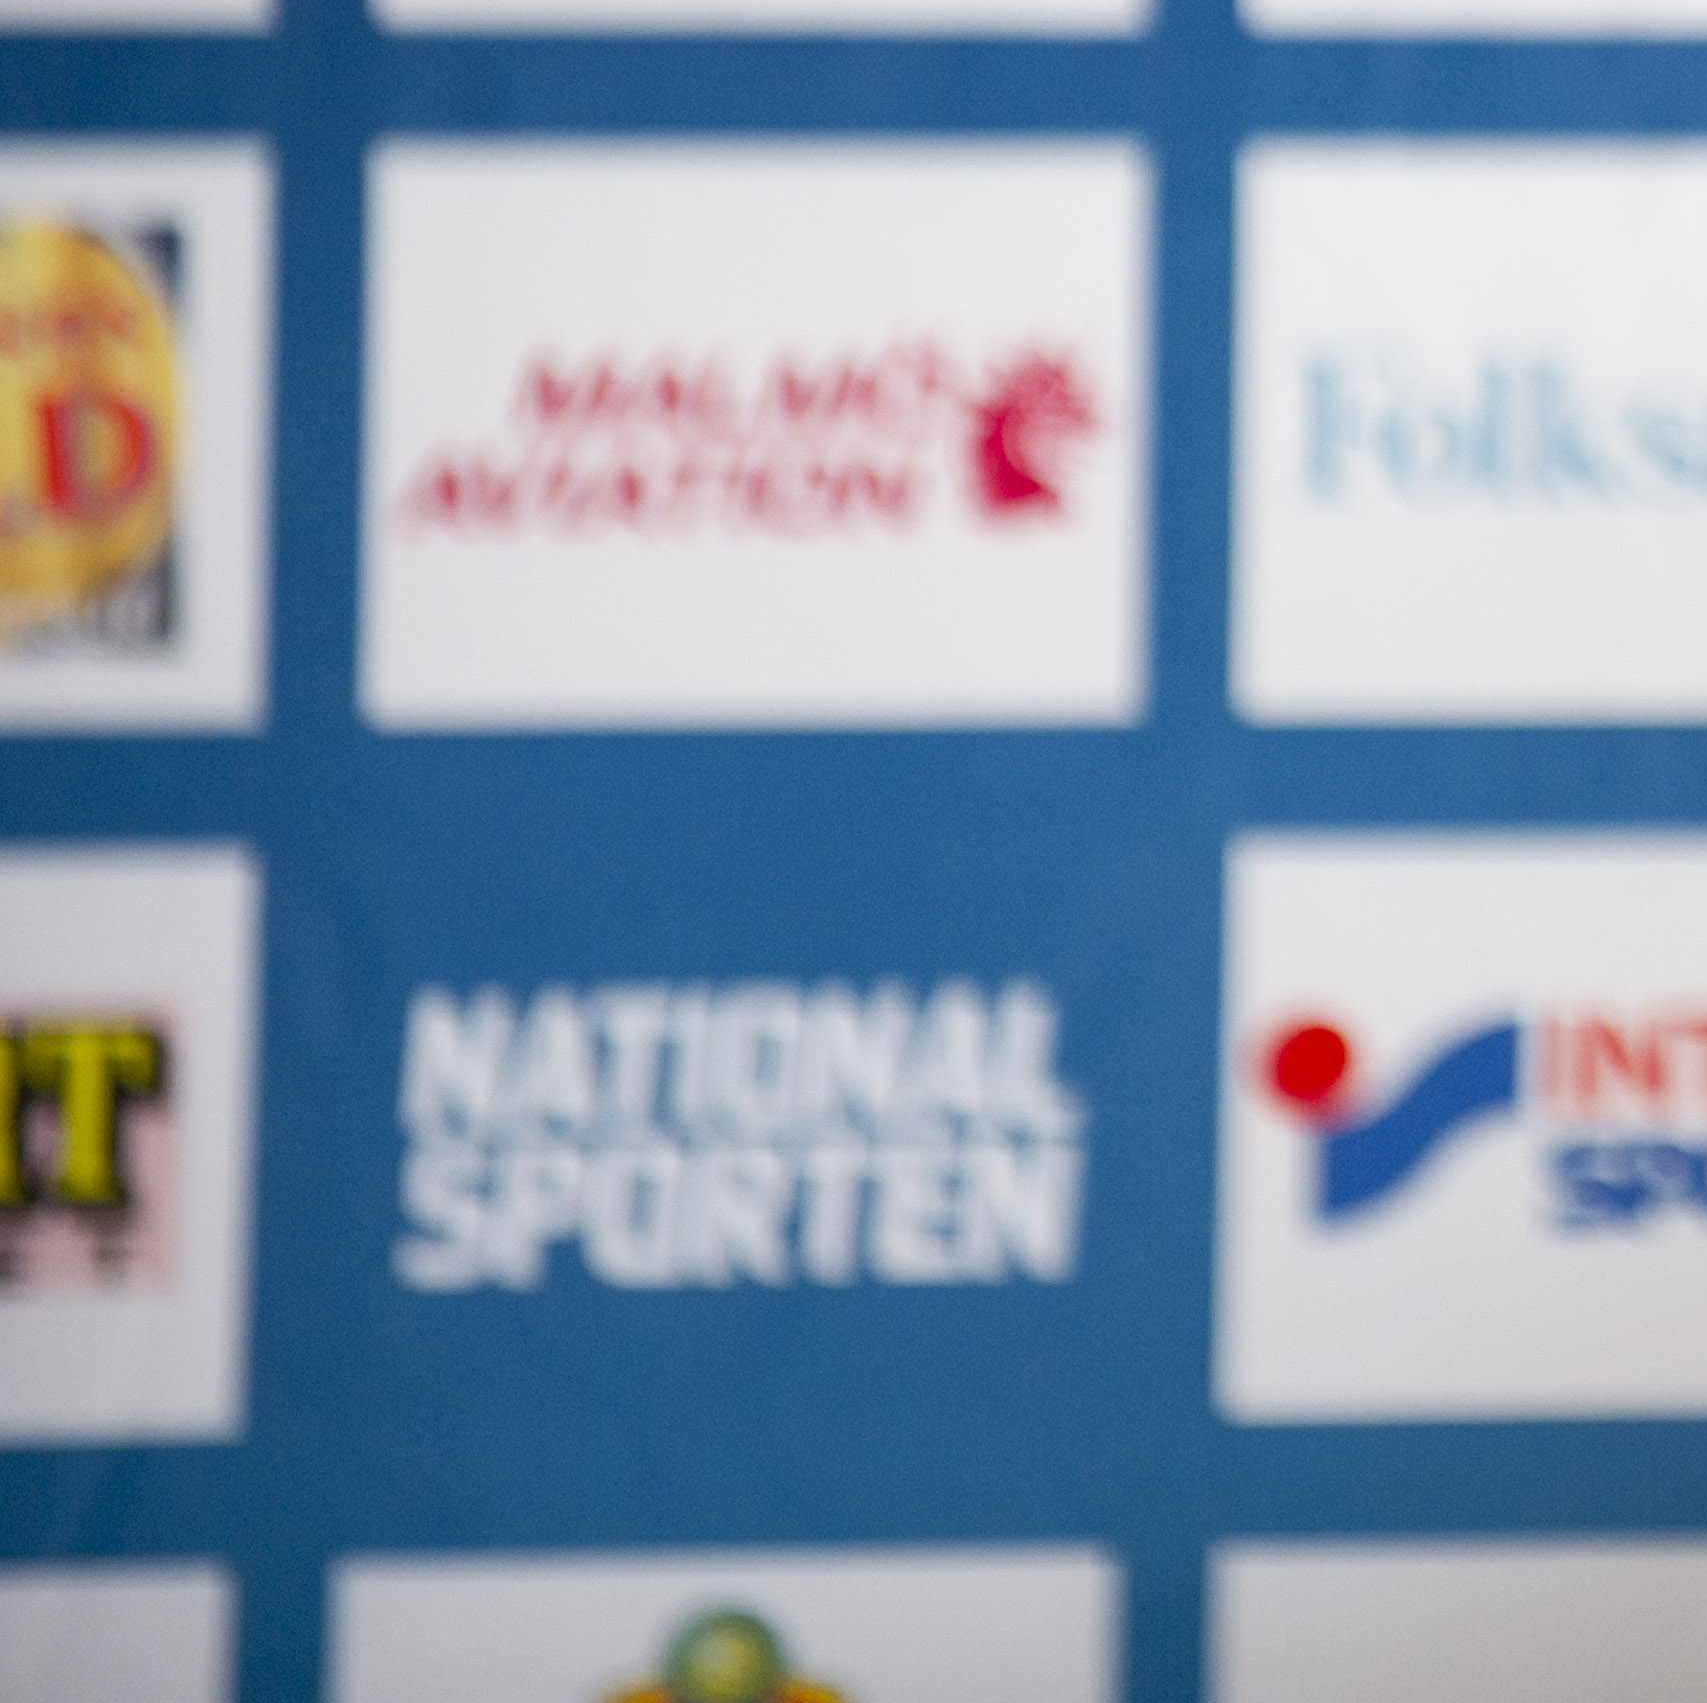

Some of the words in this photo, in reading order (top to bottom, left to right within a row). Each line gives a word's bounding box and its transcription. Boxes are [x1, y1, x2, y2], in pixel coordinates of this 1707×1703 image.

[402, 444, 922, 534] AVIATION
[403, 979, 1085, 1138] NATIONAL
[394, 1132, 1085, 1292] SPORTEN
